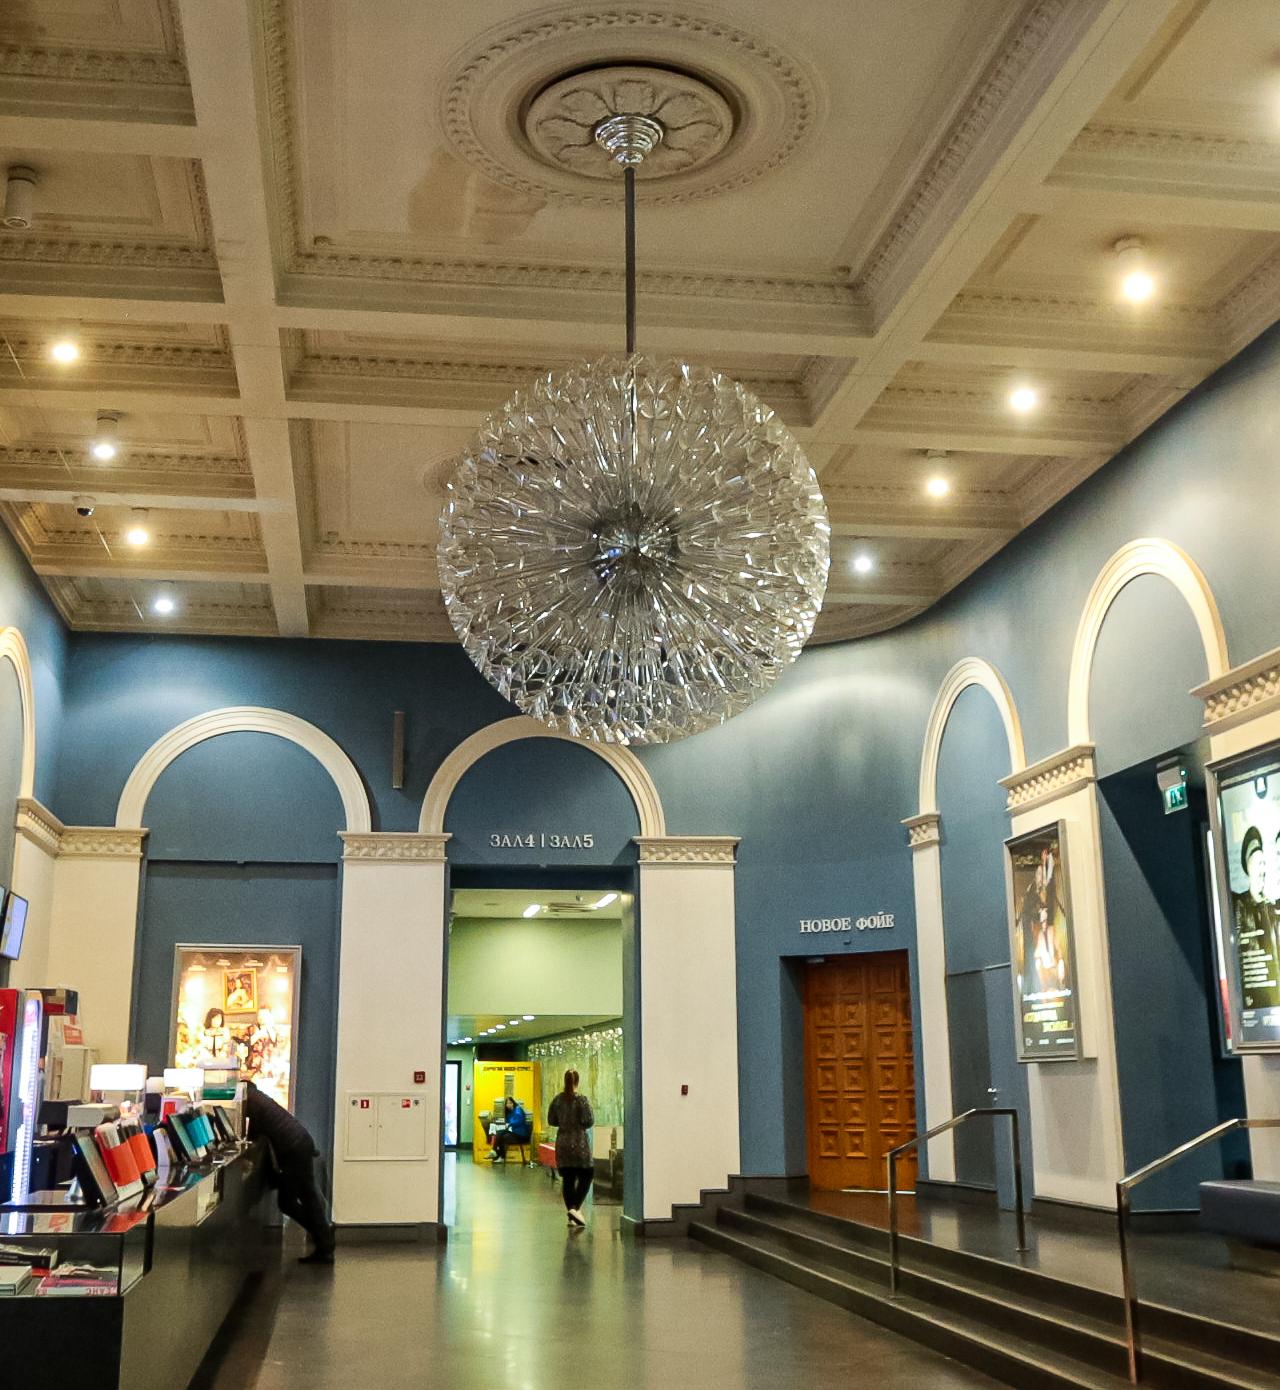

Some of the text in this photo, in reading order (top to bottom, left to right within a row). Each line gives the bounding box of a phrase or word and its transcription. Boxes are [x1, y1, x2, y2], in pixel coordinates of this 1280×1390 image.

[490, 833, 535, 848] ЗАЛ4
[550, 833, 594, 848] ЗАЛ5
[800, 911, 895, 933] НОВОЕ ФОЙЕ
